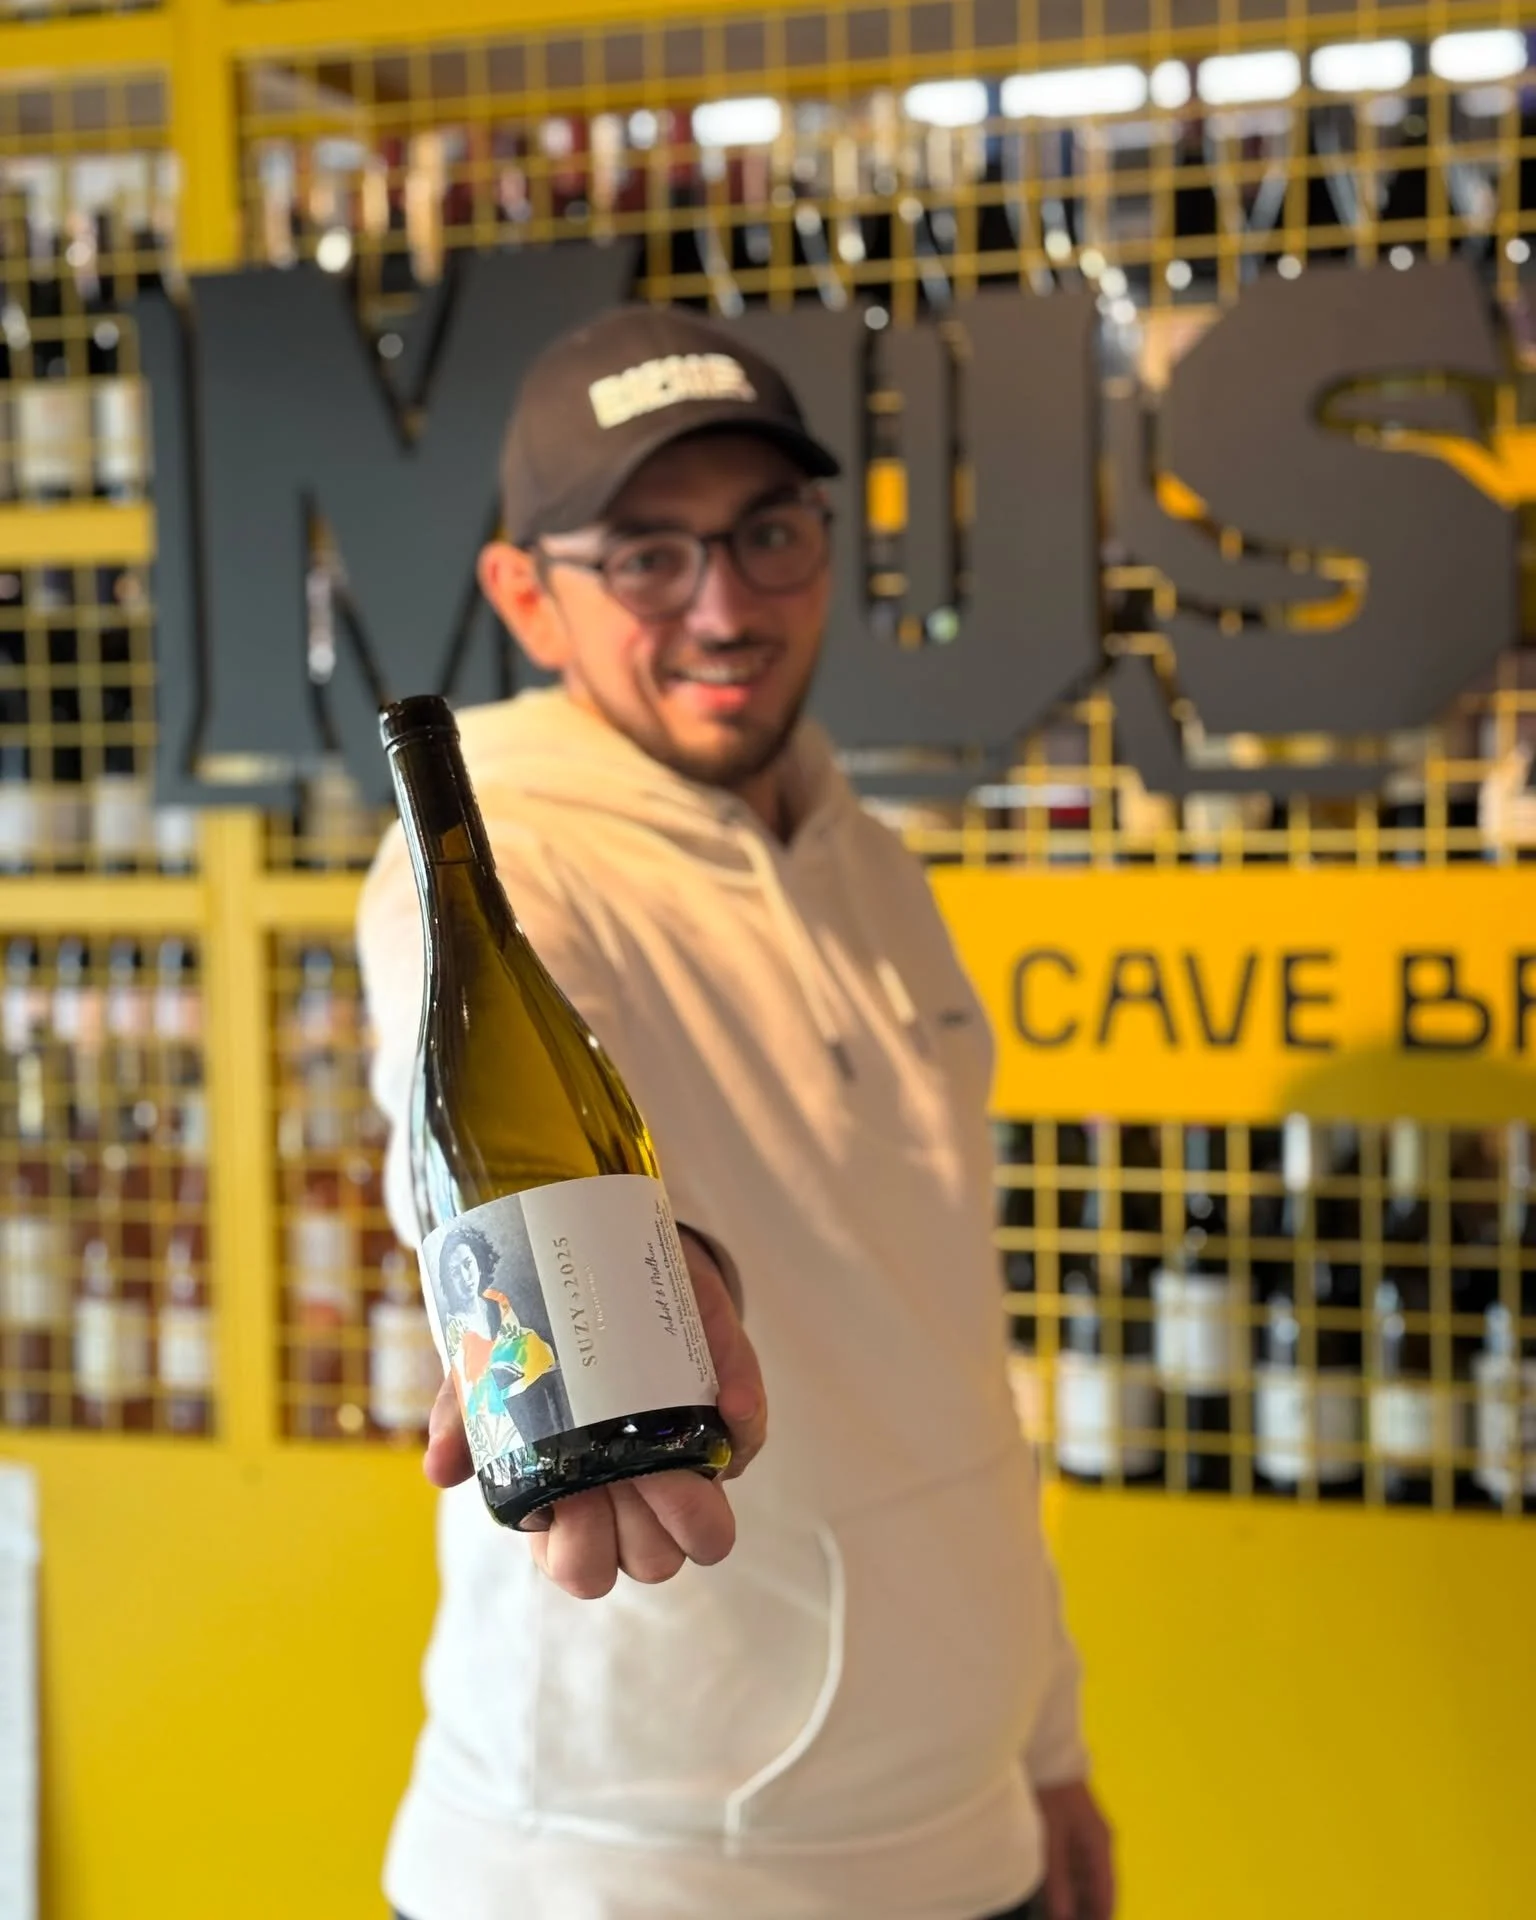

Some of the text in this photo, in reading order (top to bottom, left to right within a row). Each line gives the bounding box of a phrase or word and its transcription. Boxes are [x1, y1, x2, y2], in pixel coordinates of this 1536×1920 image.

[1011, 948, 1341, 1052] CAVE
[552, 1236, 580, 1288] 2025
[569, 1308, 598, 1369] SUZY
